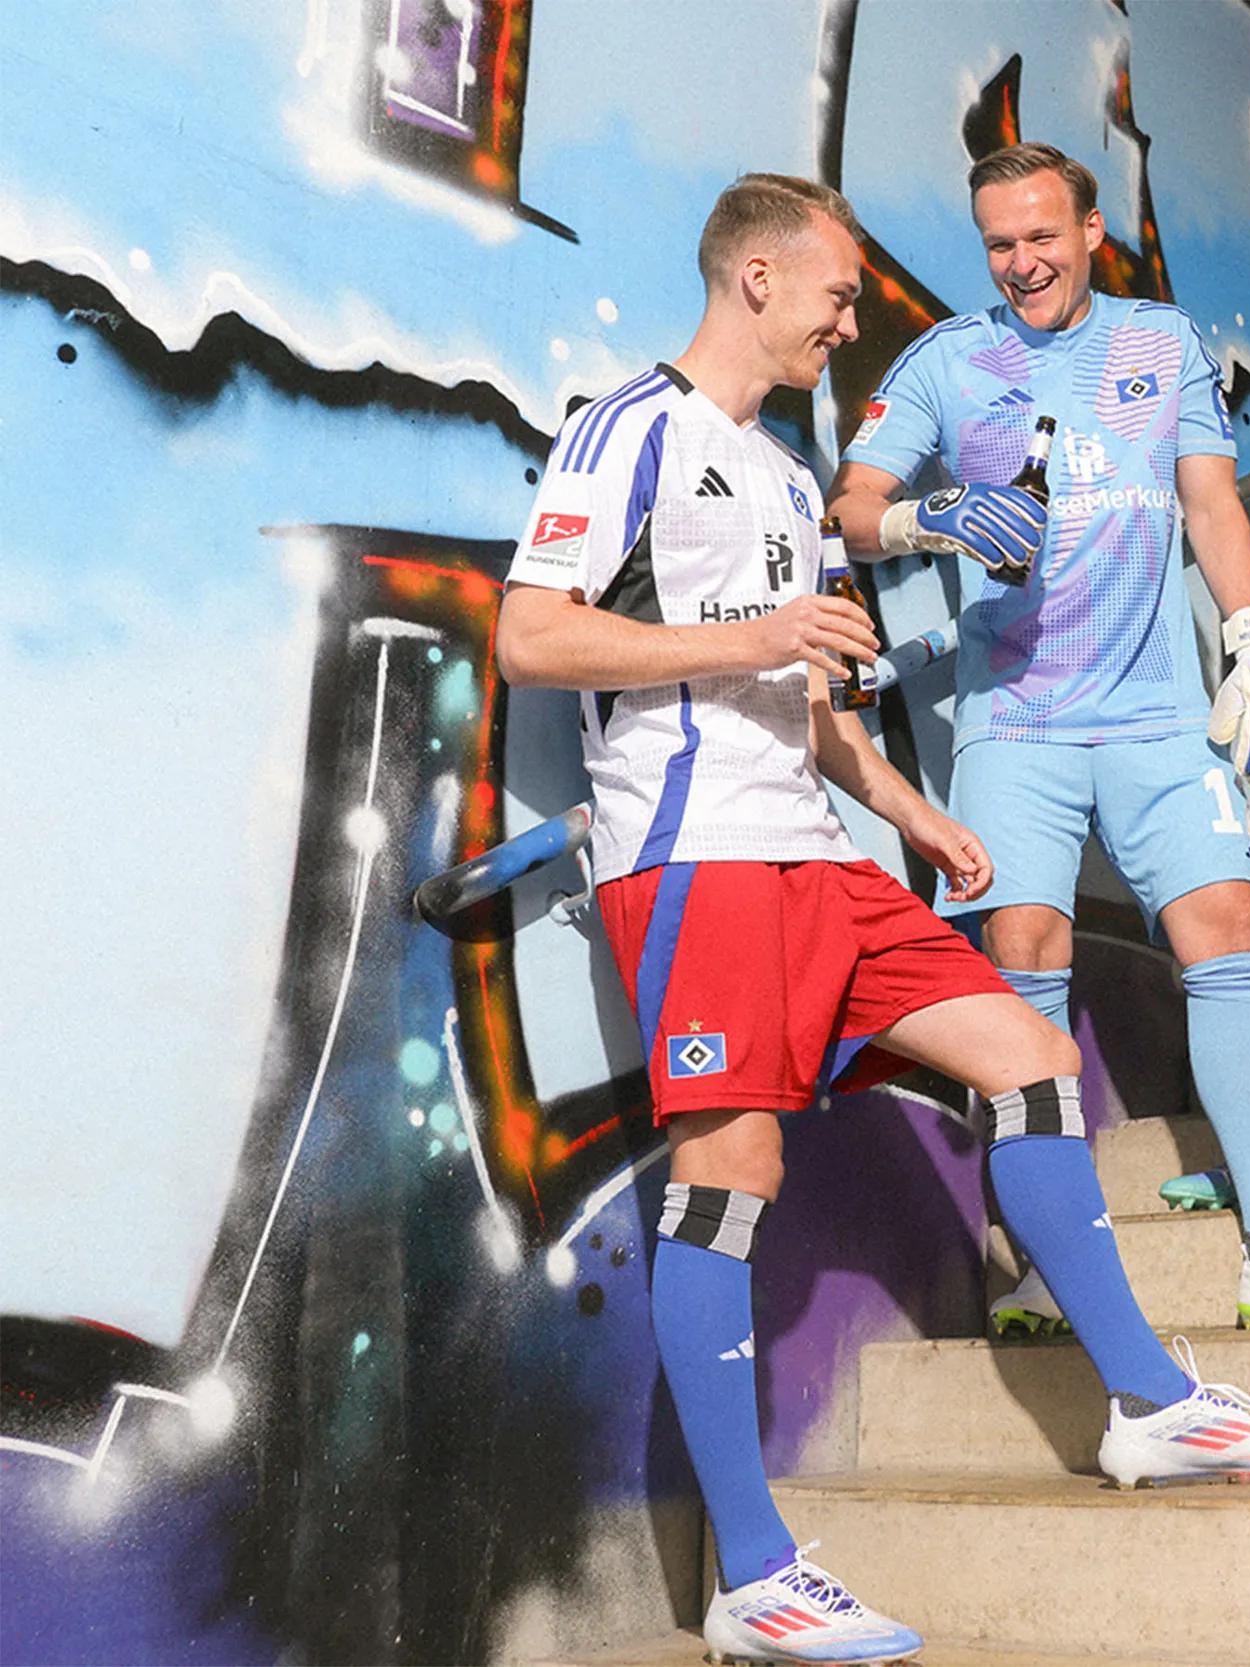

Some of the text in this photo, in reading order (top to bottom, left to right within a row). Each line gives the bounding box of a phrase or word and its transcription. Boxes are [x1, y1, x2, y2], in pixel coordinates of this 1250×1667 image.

[1049, 484, 1174, 518] seMerkur
[700, 600, 777, 622] Han
[1203, 768, 1244, 833] 1
